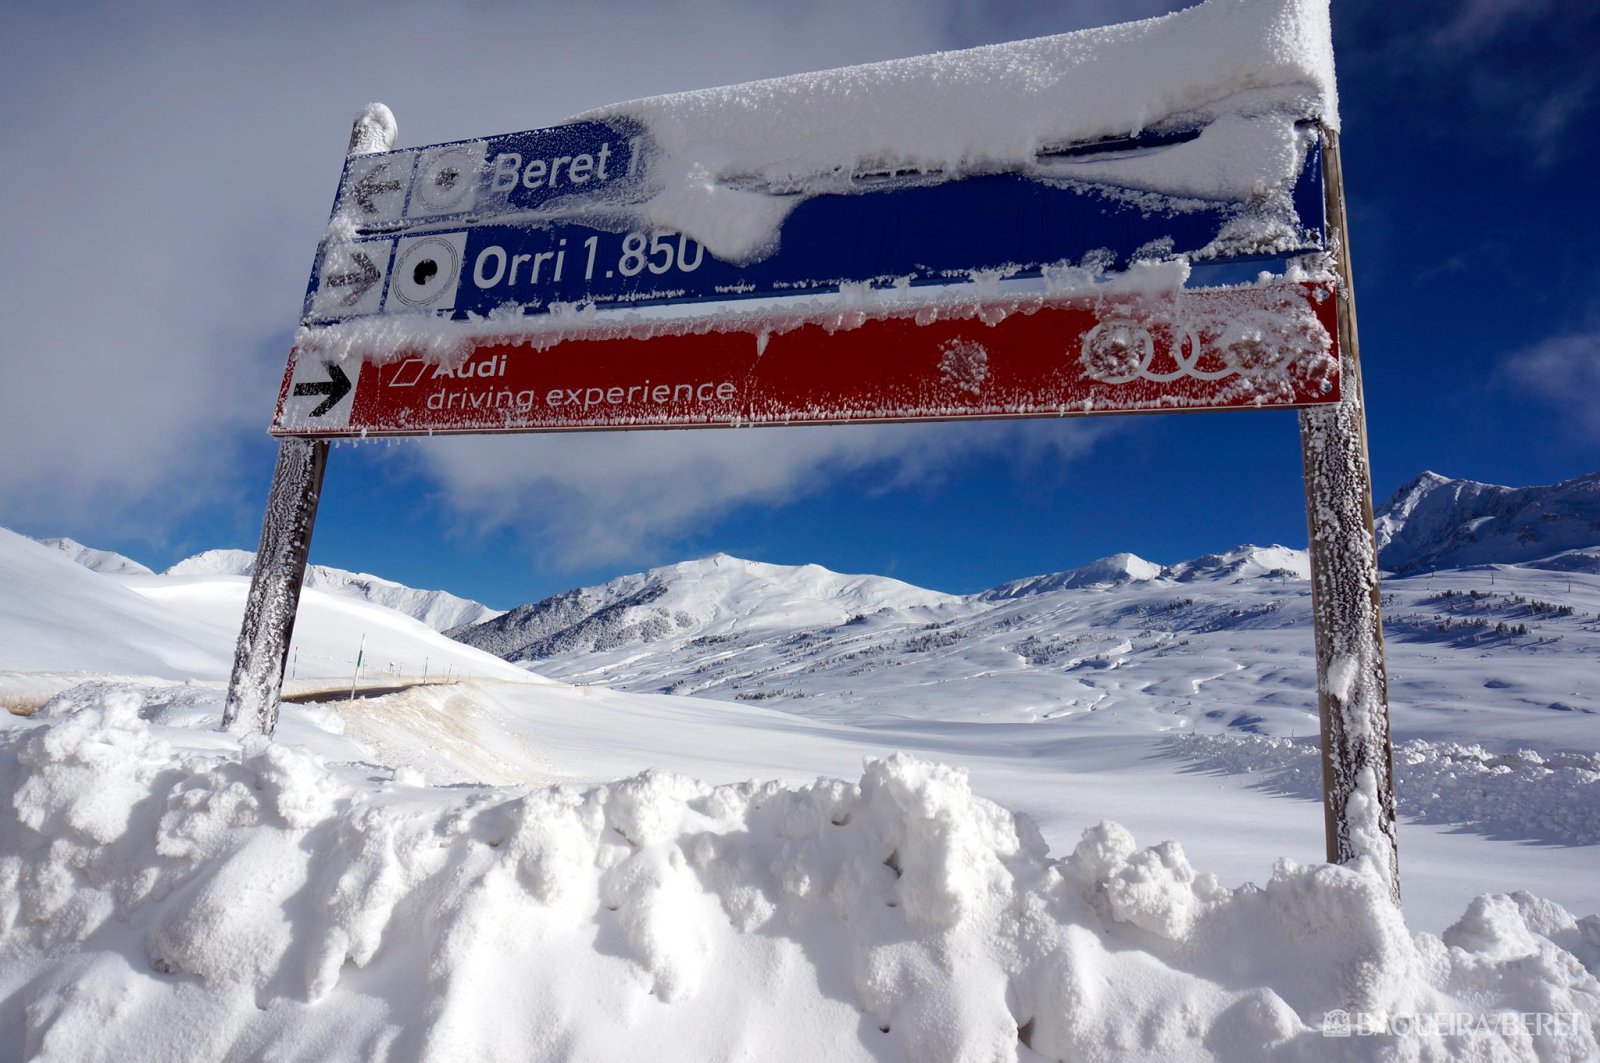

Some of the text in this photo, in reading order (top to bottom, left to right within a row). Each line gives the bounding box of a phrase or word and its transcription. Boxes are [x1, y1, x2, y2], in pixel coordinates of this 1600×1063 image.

[490, 143, 612, 193] Beret
[473, 231, 704, 289] Orri 1.850
[427, 380, 736, 413] driving experience
